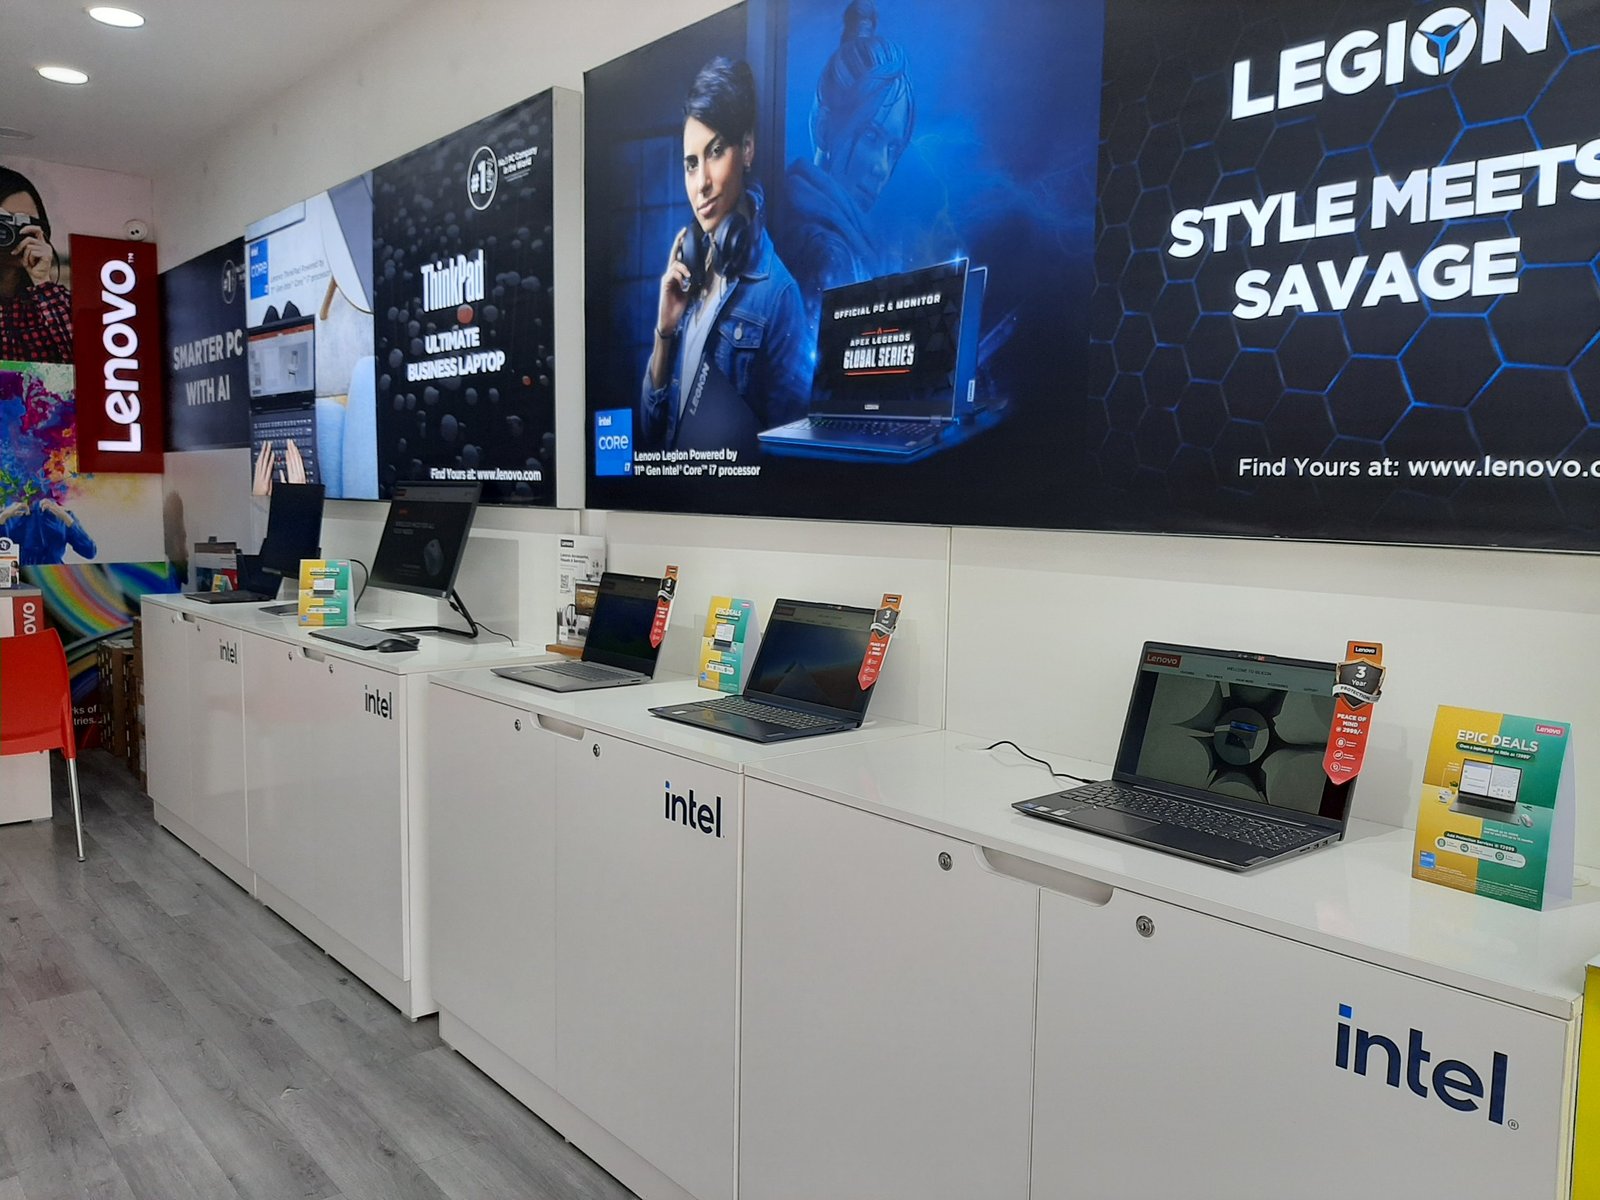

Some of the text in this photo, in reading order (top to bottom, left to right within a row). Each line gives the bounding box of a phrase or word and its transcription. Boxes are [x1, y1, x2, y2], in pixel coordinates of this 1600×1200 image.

[1231, 0, 1551, 120] LEGION
[1167, 137, 1600, 259] STYLE MEETS
[420, 249, 484, 313] ThinkPad
[1231, 236, 1521, 320] SAVAGE
[834, 306, 871, 320] OFFICIAL
[873, 303, 885, 314] PC
[895, 292, 941, 310] MONITOR
[173, 328, 243, 371] SMARTER PC
[424, 327, 480, 354] ULTIMATE
[850, 332, 911, 347] APEX LEGENDS
[407, 350, 505, 382] BUSINESS LAPTOP
[843, 344, 915, 369] GLOBAL SERIES
[186, 374, 231, 406] WITH AI
[634, 449, 737, 462] Lenovo Legion Powered by
[1238, 457, 1286, 477] Find
[1294, 457, 1360, 477] Yours
[1368, 458, 1400, 477] at:
[430, 468, 445, 480] Find
[447, 468, 466, 480] Yours
[476, 468, 542, 481] www.lenovo.com
[646, 465, 661, 476] Gen
[709, 464, 717, 476] i7
[718, 465, 761, 477] processor
[23, 602, 36, 634] ovo
[884, 610, 891, 619] 3
[219, 639, 238, 664] intel
[1147, 653, 1178, 665] Lenovo
[1351, 679, 1367, 687] Year
[1355, 665, 1367, 678] 3
[365, 684, 392, 720] intel
[1340, 686, 1370, 700] PROTECTION
[87, 704, 97, 713] of
[1336, 713, 1357, 721] PEACE
[1456, 729, 1539, 752] EPIC DEALS
[1536, 726, 1561, 735] Lenovo
[665, 780, 721, 838] intel
